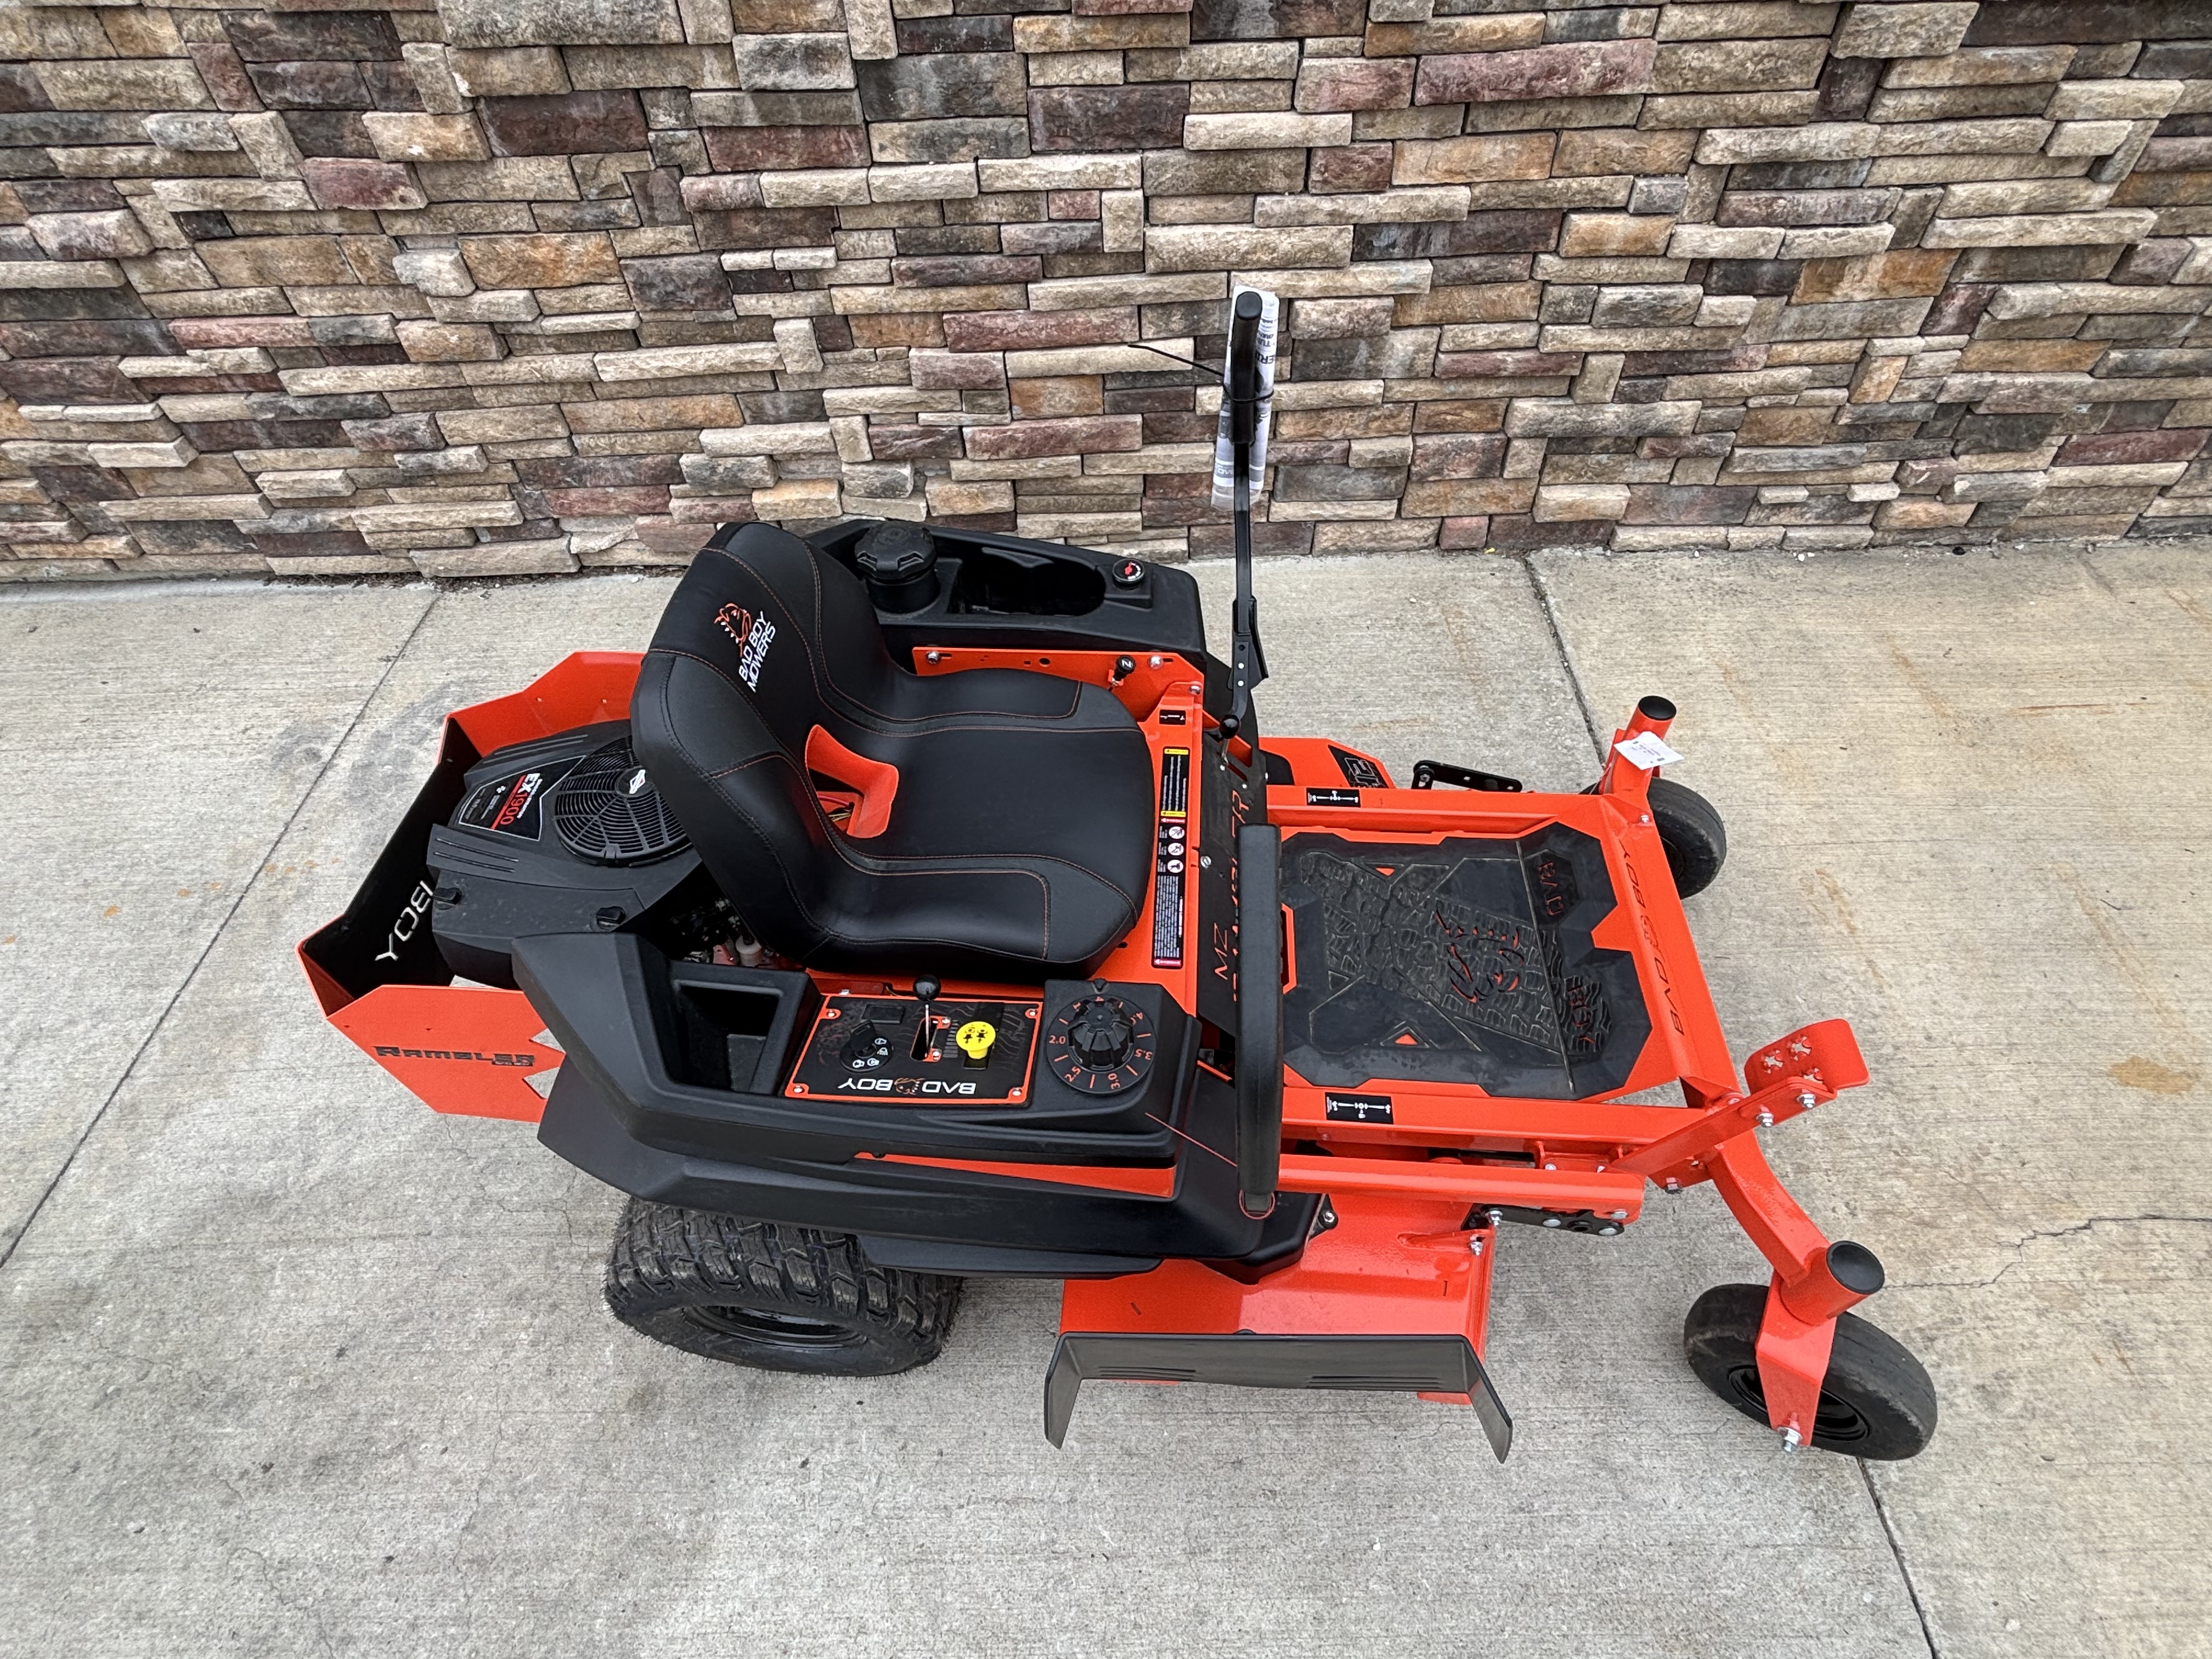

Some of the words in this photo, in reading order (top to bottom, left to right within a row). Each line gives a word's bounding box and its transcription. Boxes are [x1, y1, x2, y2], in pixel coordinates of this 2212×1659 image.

[739, 645, 753, 681] BAD
[748, 611, 767, 647] BOY
[747, 622, 776, 693] MOWERS
[500, 773, 540, 825] EX1900
[1538, 861, 1564, 916] BAD
[1618, 839, 1646, 909] BOY
[375, 881, 433, 961] BOY
[1214, 922, 1228, 980] MZ
[1655, 957, 1685, 1036] BAD
[1049, 1035, 1066, 1045] 2.0
[1134, 1048, 1153, 1060] 3.5
[838, 1077, 893, 1091] BOY
[922, 1081, 976, 1094] BAD
[1064, 1066, 1081, 1082] 2.5
[1107, 1073, 1120, 1090] 3.0
